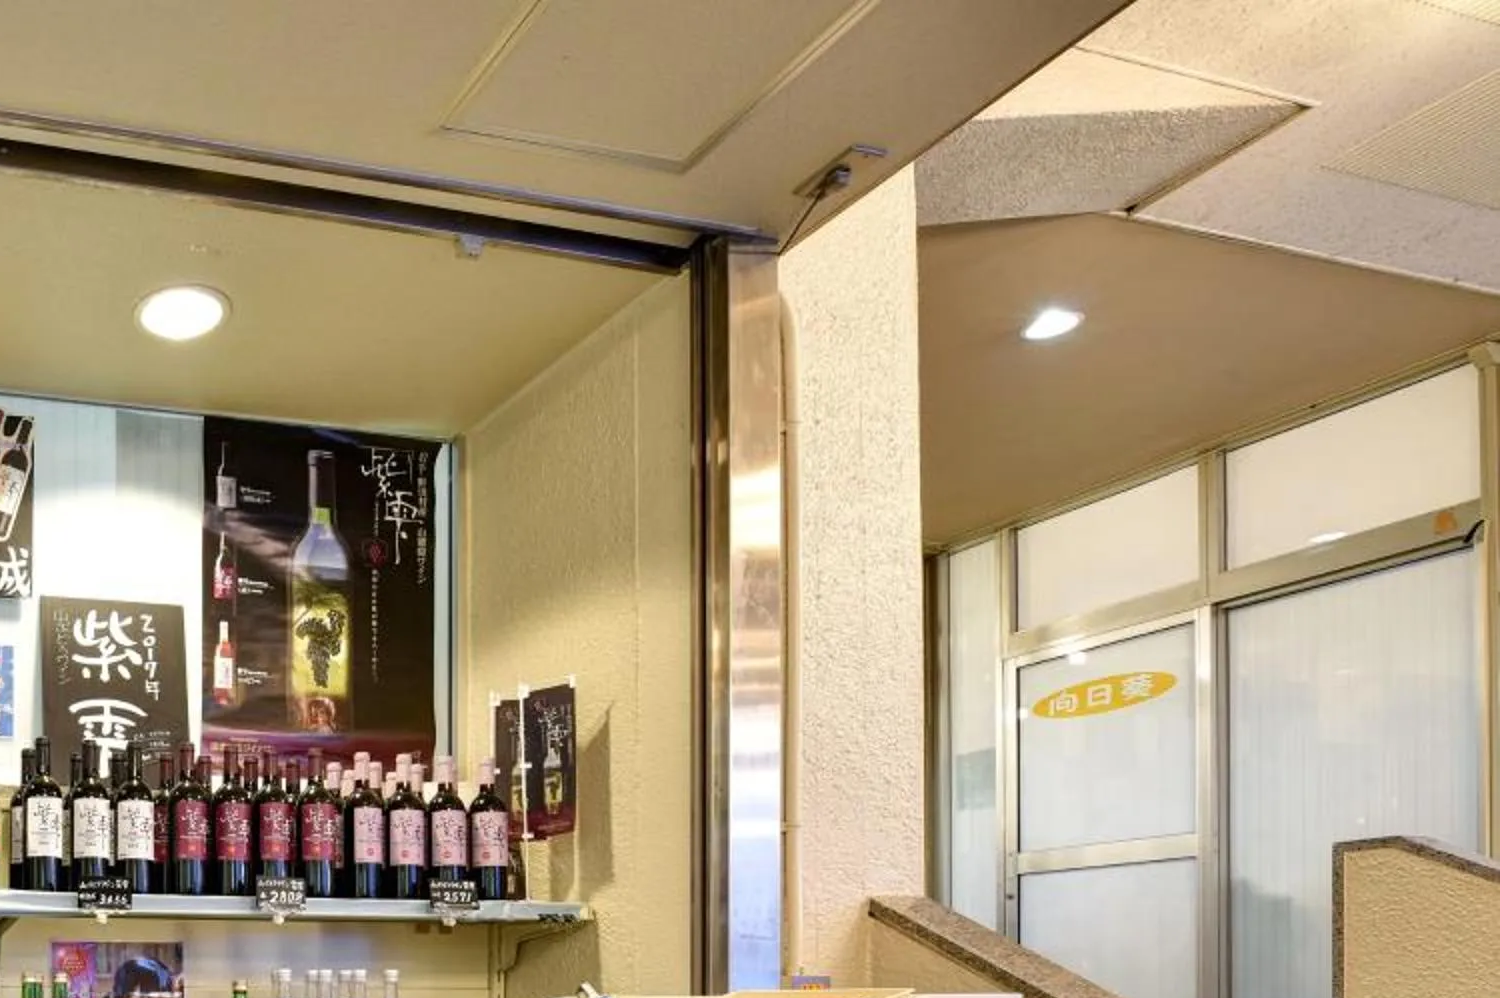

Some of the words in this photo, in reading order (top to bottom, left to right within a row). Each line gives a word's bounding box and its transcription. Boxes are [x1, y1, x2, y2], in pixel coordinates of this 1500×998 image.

[67, 608, 149, 780] 紫雫
[139, 613, 162, 702] 2017年
[1048, 673, 1154, 717] 向日葵
